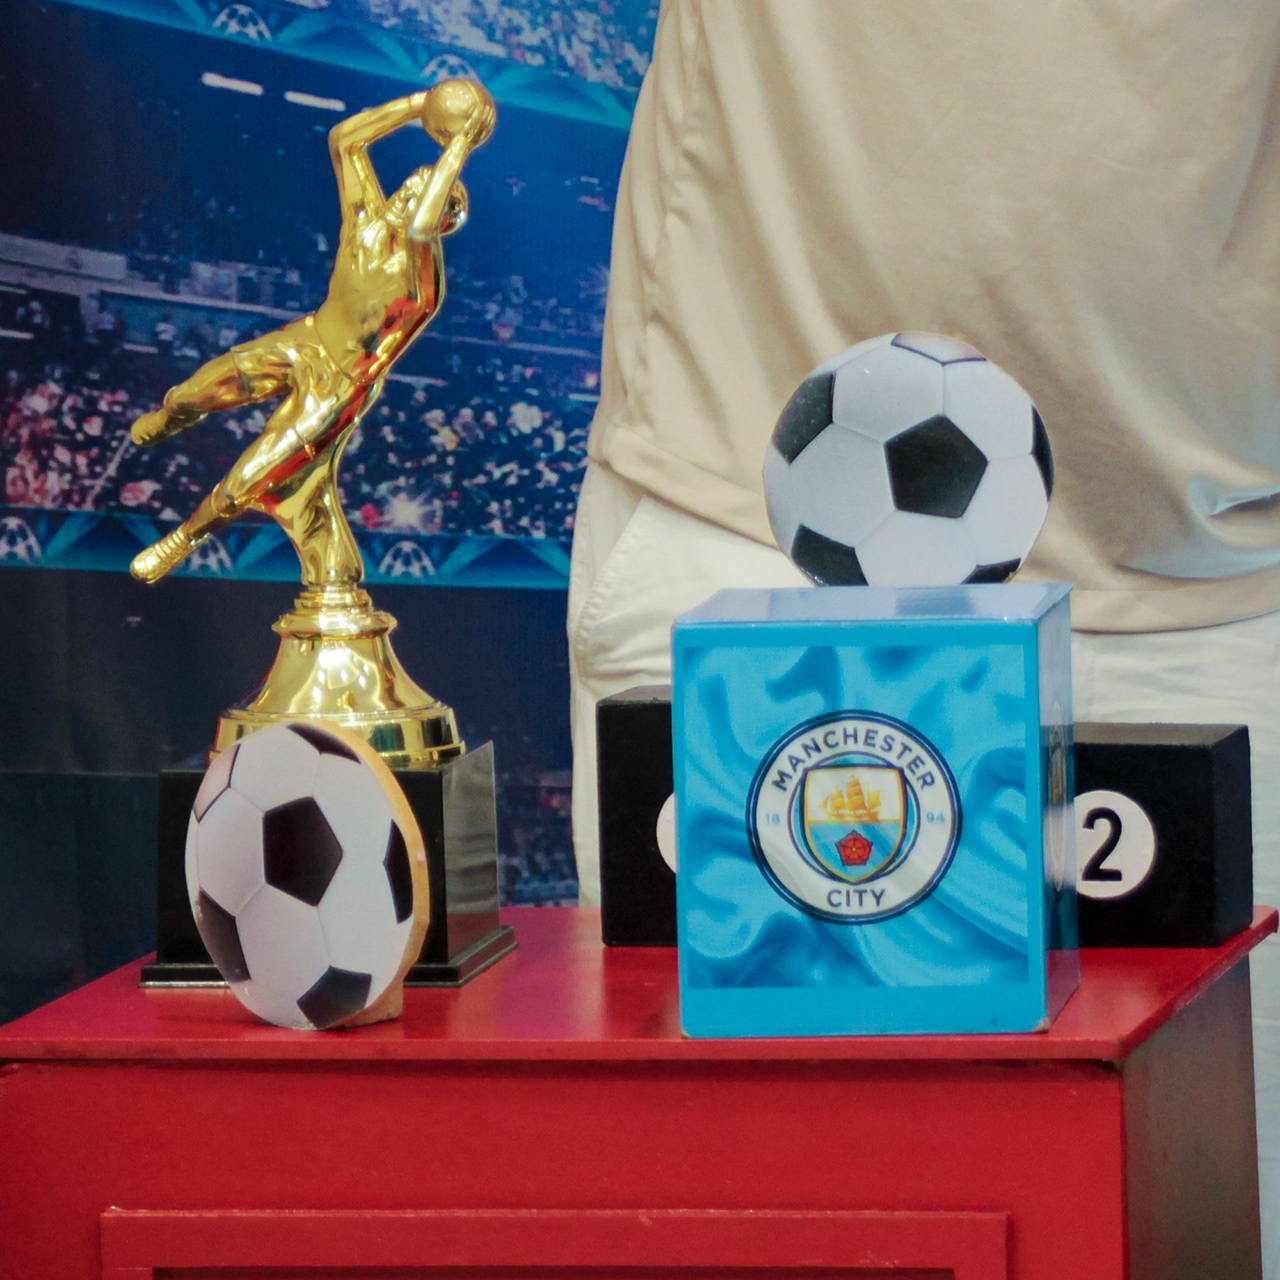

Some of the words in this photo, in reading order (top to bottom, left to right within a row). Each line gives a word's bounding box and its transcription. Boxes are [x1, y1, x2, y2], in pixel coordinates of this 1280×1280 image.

[771, 727, 936, 794] MANCHESTER
[764, 812, 781, 826] 18
[925, 811, 947, 826] 94
[1081, 806, 1123, 882] 2
[826, 887, 887, 909] CITY
